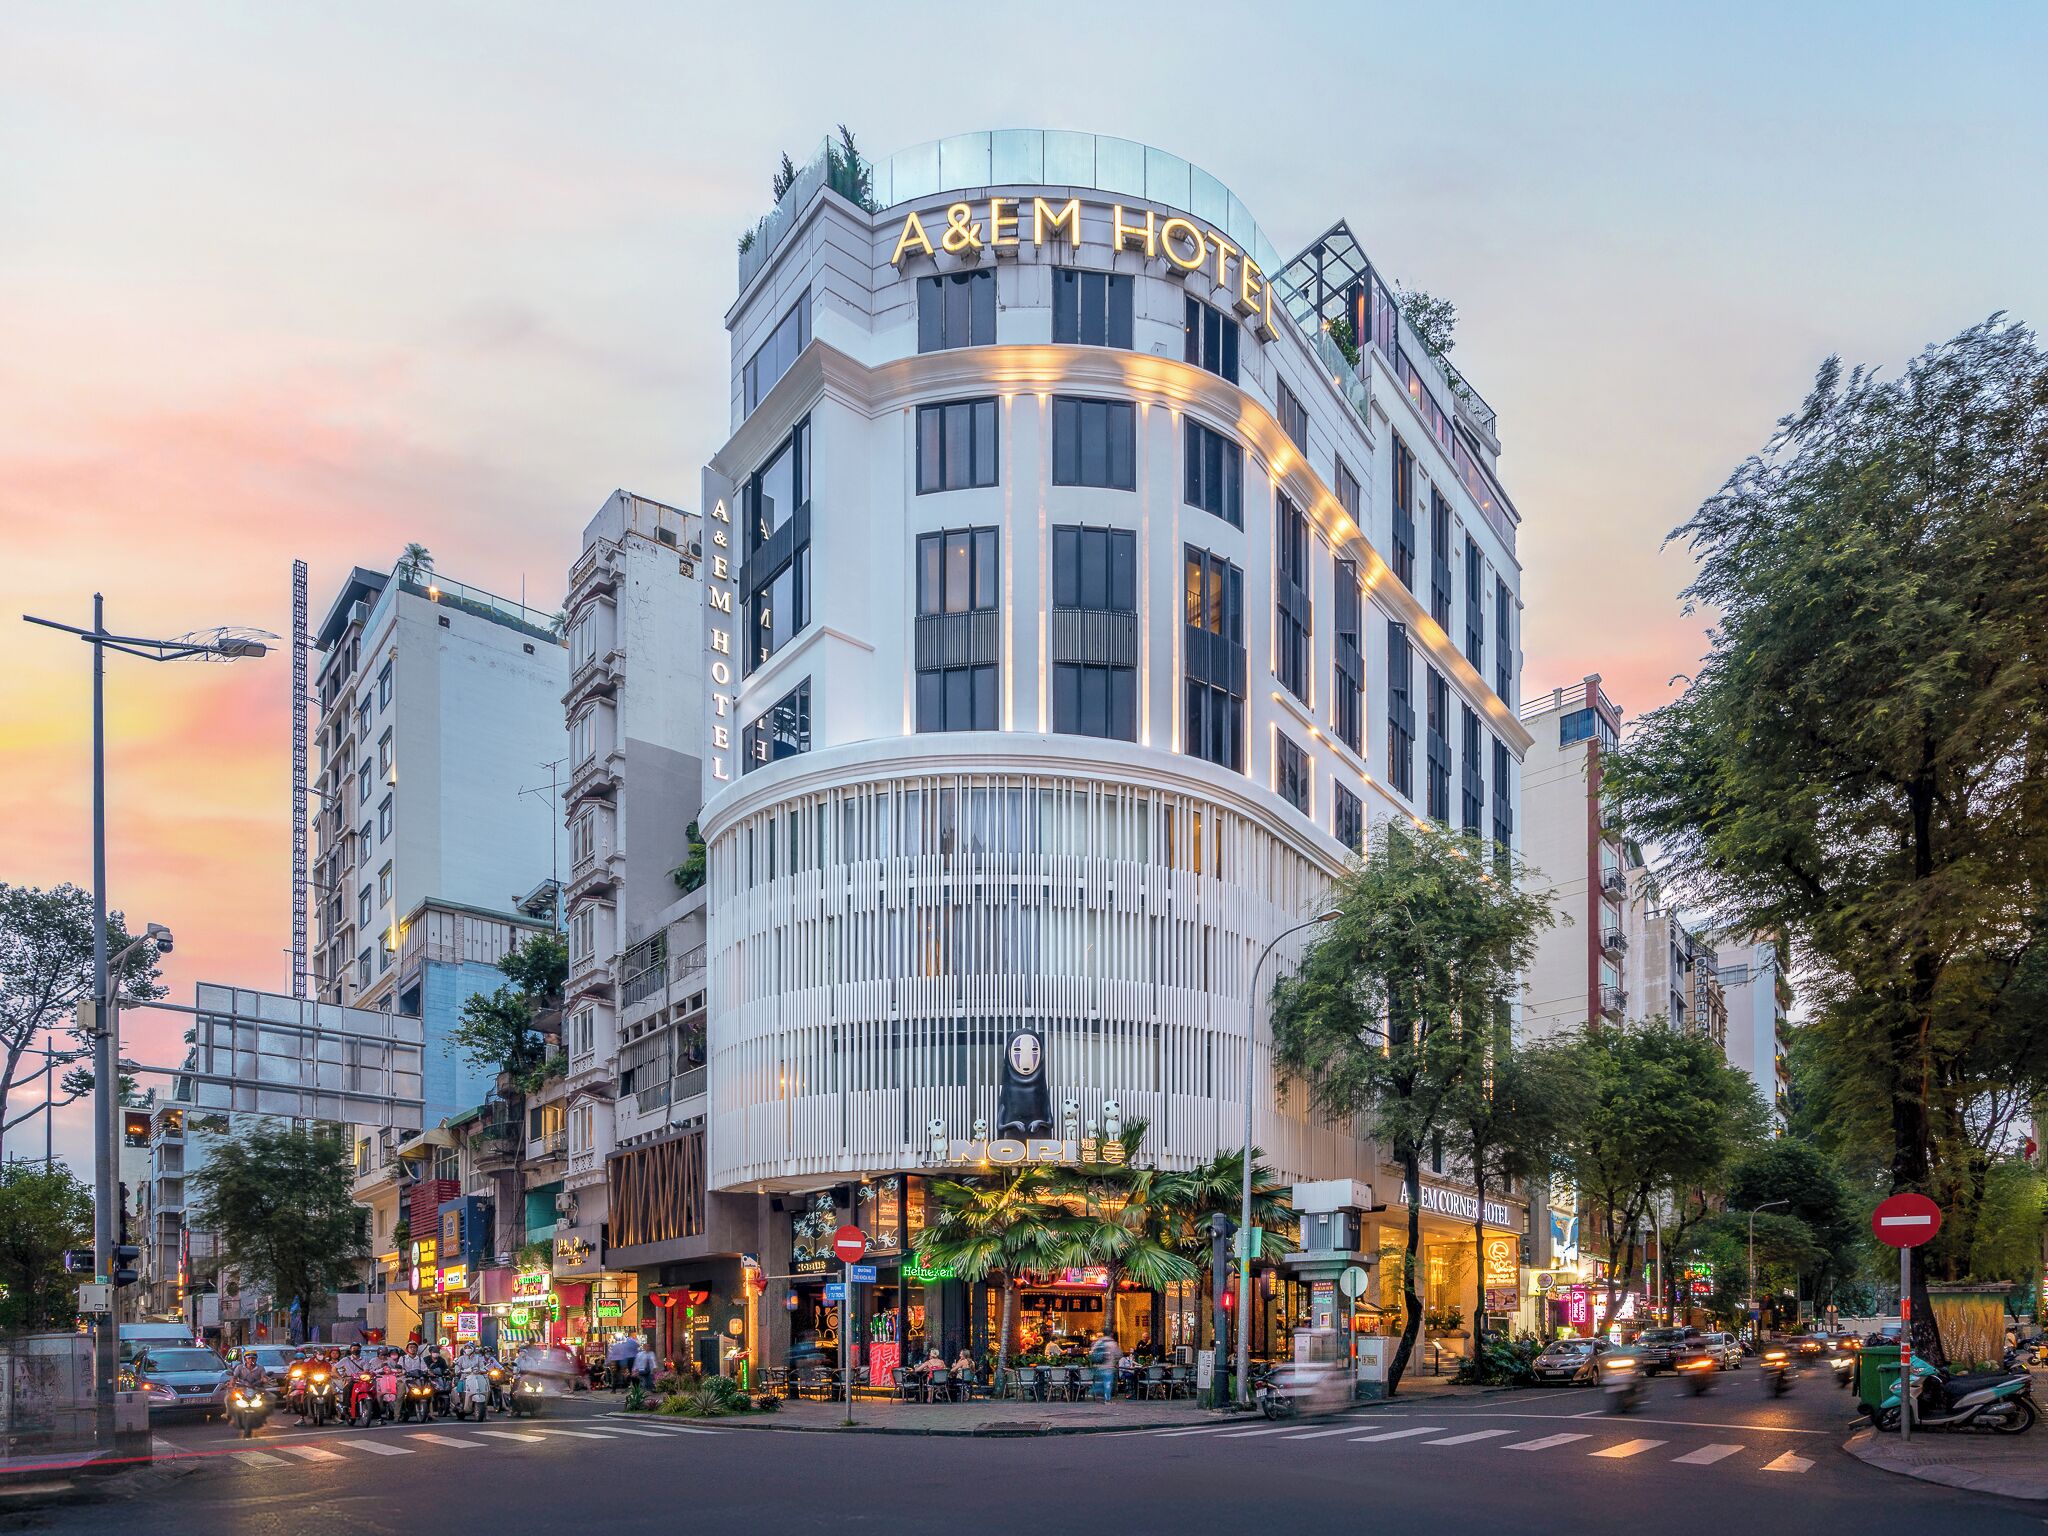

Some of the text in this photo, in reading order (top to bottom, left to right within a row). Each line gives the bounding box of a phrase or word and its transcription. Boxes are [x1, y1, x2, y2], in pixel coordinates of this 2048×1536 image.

[890, 197, 1280, 343] A&EM HOTEL
[710, 628, 730, 780] HOTEL
[949, 1139, 1077, 1163] NORI
[1438, 1190, 1479, 1218] CORNER
[903, 1266, 953, 1277] Heineken
